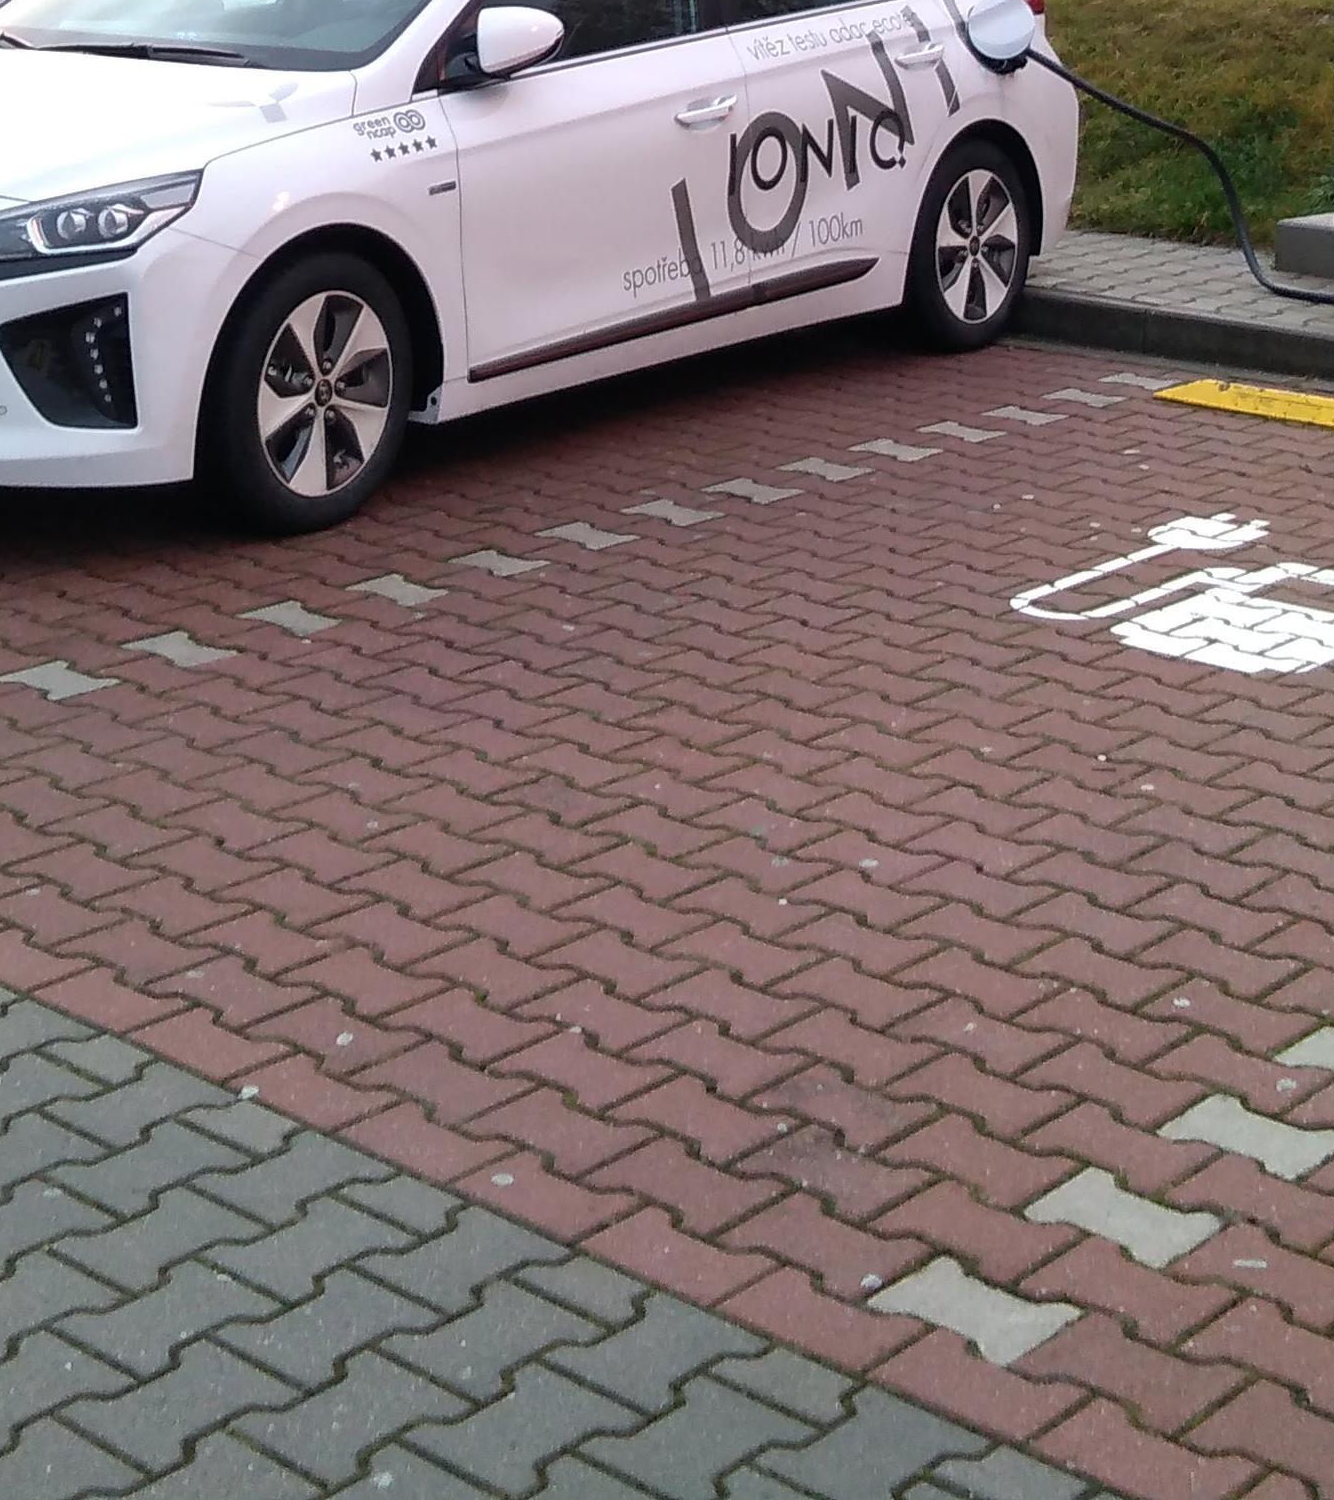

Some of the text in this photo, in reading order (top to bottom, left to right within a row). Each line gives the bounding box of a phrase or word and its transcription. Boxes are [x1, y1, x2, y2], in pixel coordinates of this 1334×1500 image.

[788, 28, 827, 51] testu
[353, 116, 391, 137] green
[366, 126, 397, 140] ncap
[710, 237, 746, 273] 11,8
[808, 211, 864, 248] 100km
